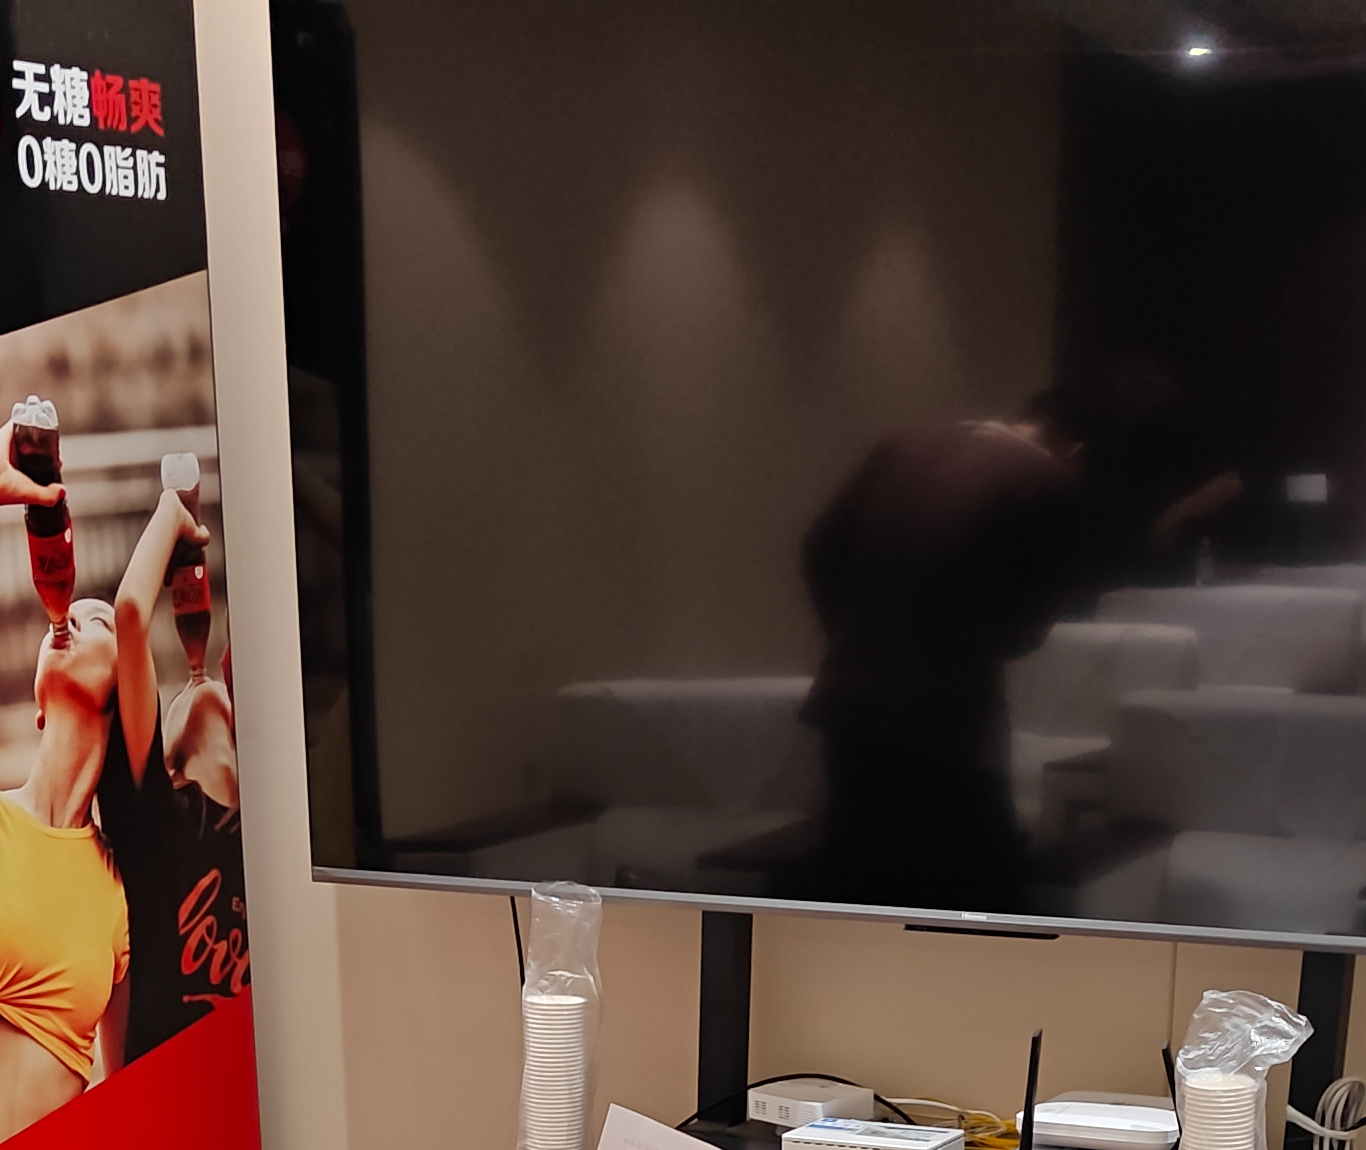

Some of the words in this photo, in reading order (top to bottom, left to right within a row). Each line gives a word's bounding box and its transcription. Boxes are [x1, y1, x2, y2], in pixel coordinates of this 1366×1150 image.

[11, 59, 165, 138] 无糖畅爽
[17, 134, 169, 201] 0糖0脂肪
